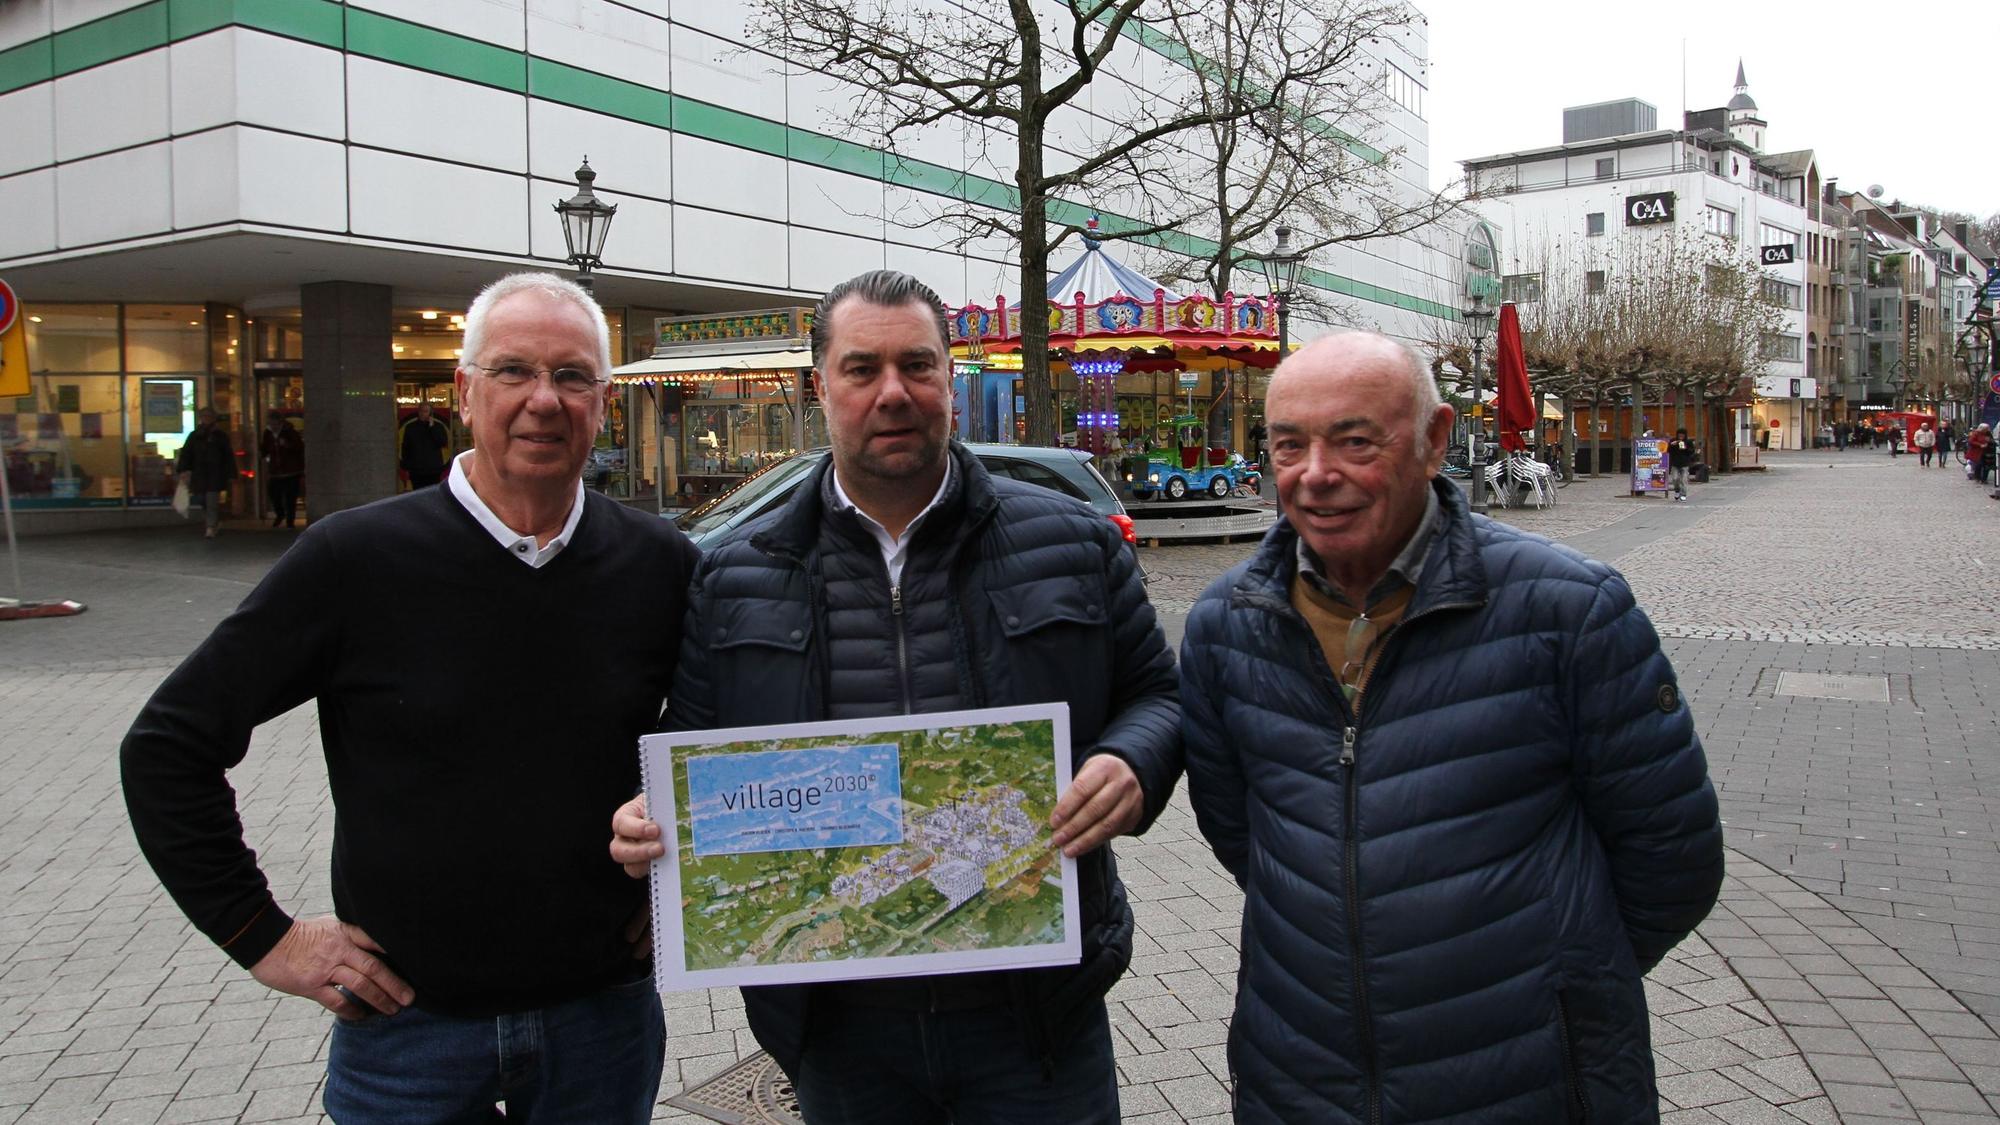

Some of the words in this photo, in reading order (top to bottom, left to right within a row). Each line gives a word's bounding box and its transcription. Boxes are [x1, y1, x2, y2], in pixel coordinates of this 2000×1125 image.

[1631, 198, 1667, 220] C&A
[1764, 247, 1789, 261] C&A
[722, 783, 822, 814] village
